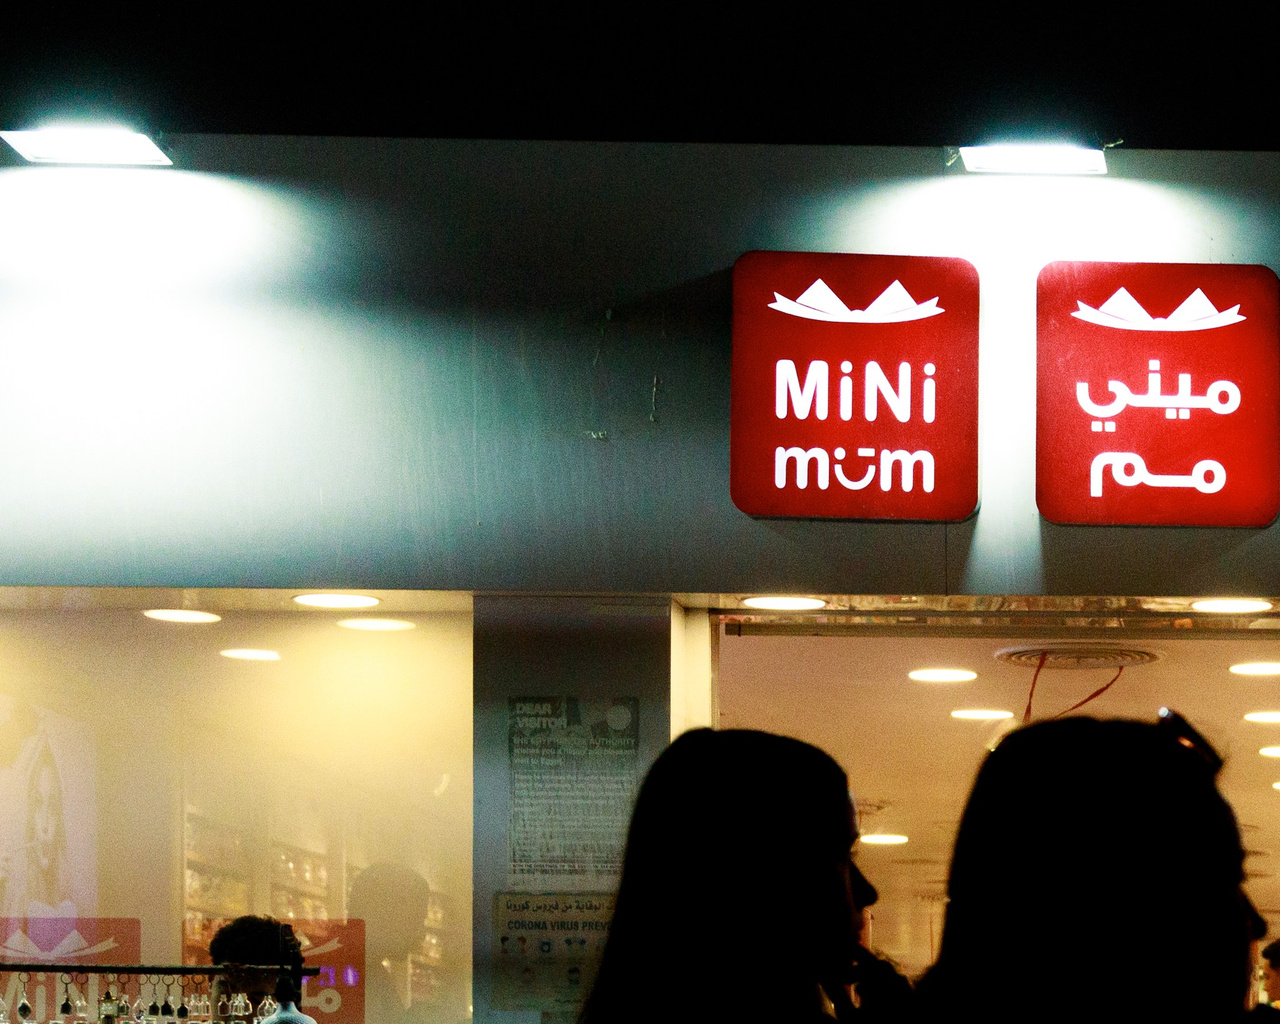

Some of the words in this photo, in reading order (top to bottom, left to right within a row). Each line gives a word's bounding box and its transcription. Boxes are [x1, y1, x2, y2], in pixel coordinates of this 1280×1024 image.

[775, 359, 936, 424] MiNi
[1076, 359, 1242, 433] ميني
[515, 703, 552, 714] DEAR
[516, 717, 568, 728] VISITOR
[507, 920, 548, 931] CORONA
[551, 920, 579, 931] VIRUS
